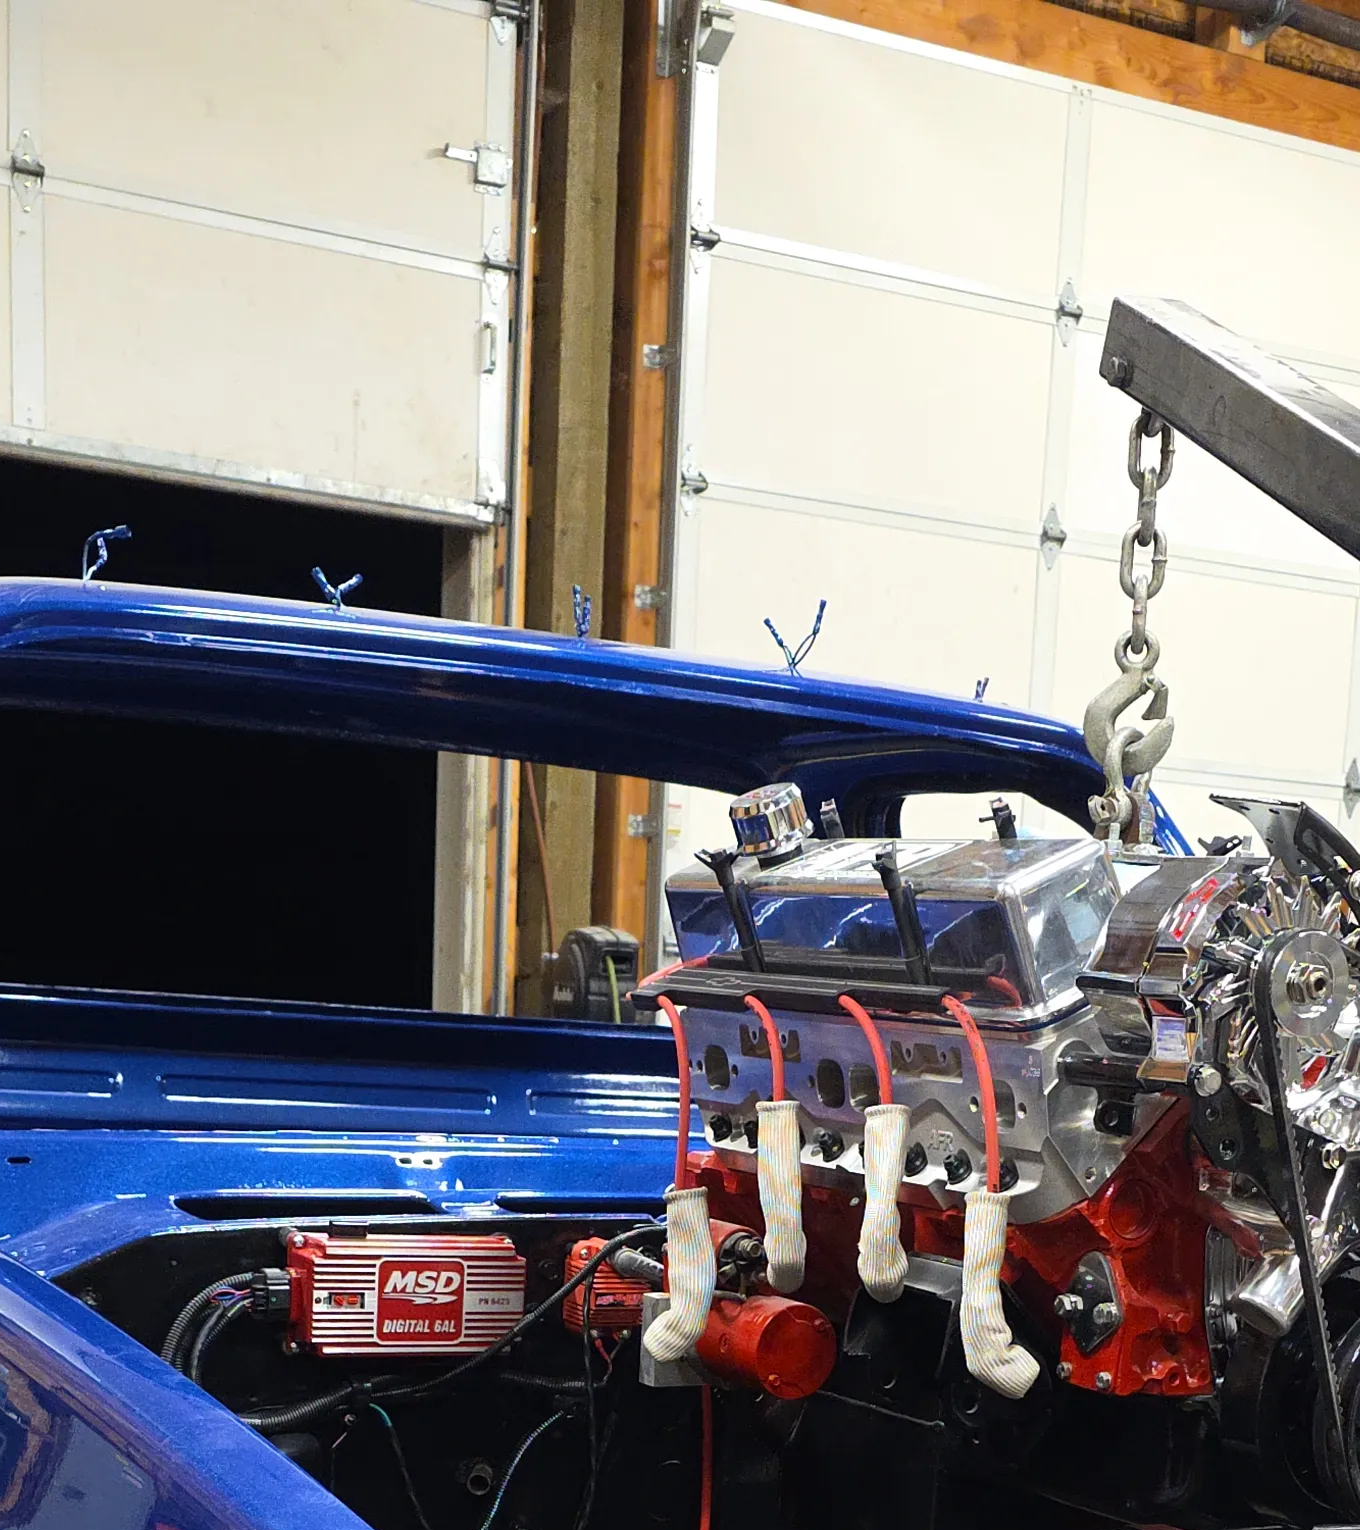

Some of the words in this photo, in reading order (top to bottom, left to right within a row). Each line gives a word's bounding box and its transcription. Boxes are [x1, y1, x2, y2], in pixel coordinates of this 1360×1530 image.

[927, 1129, 954, 1152] AFR
[383, 1270, 461, 1294] MSD
[478, 1297, 489, 1306] PN
[382, 1319, 431, 1333] DIGITAL
[433, 1319, 457, 1333] 6AL
